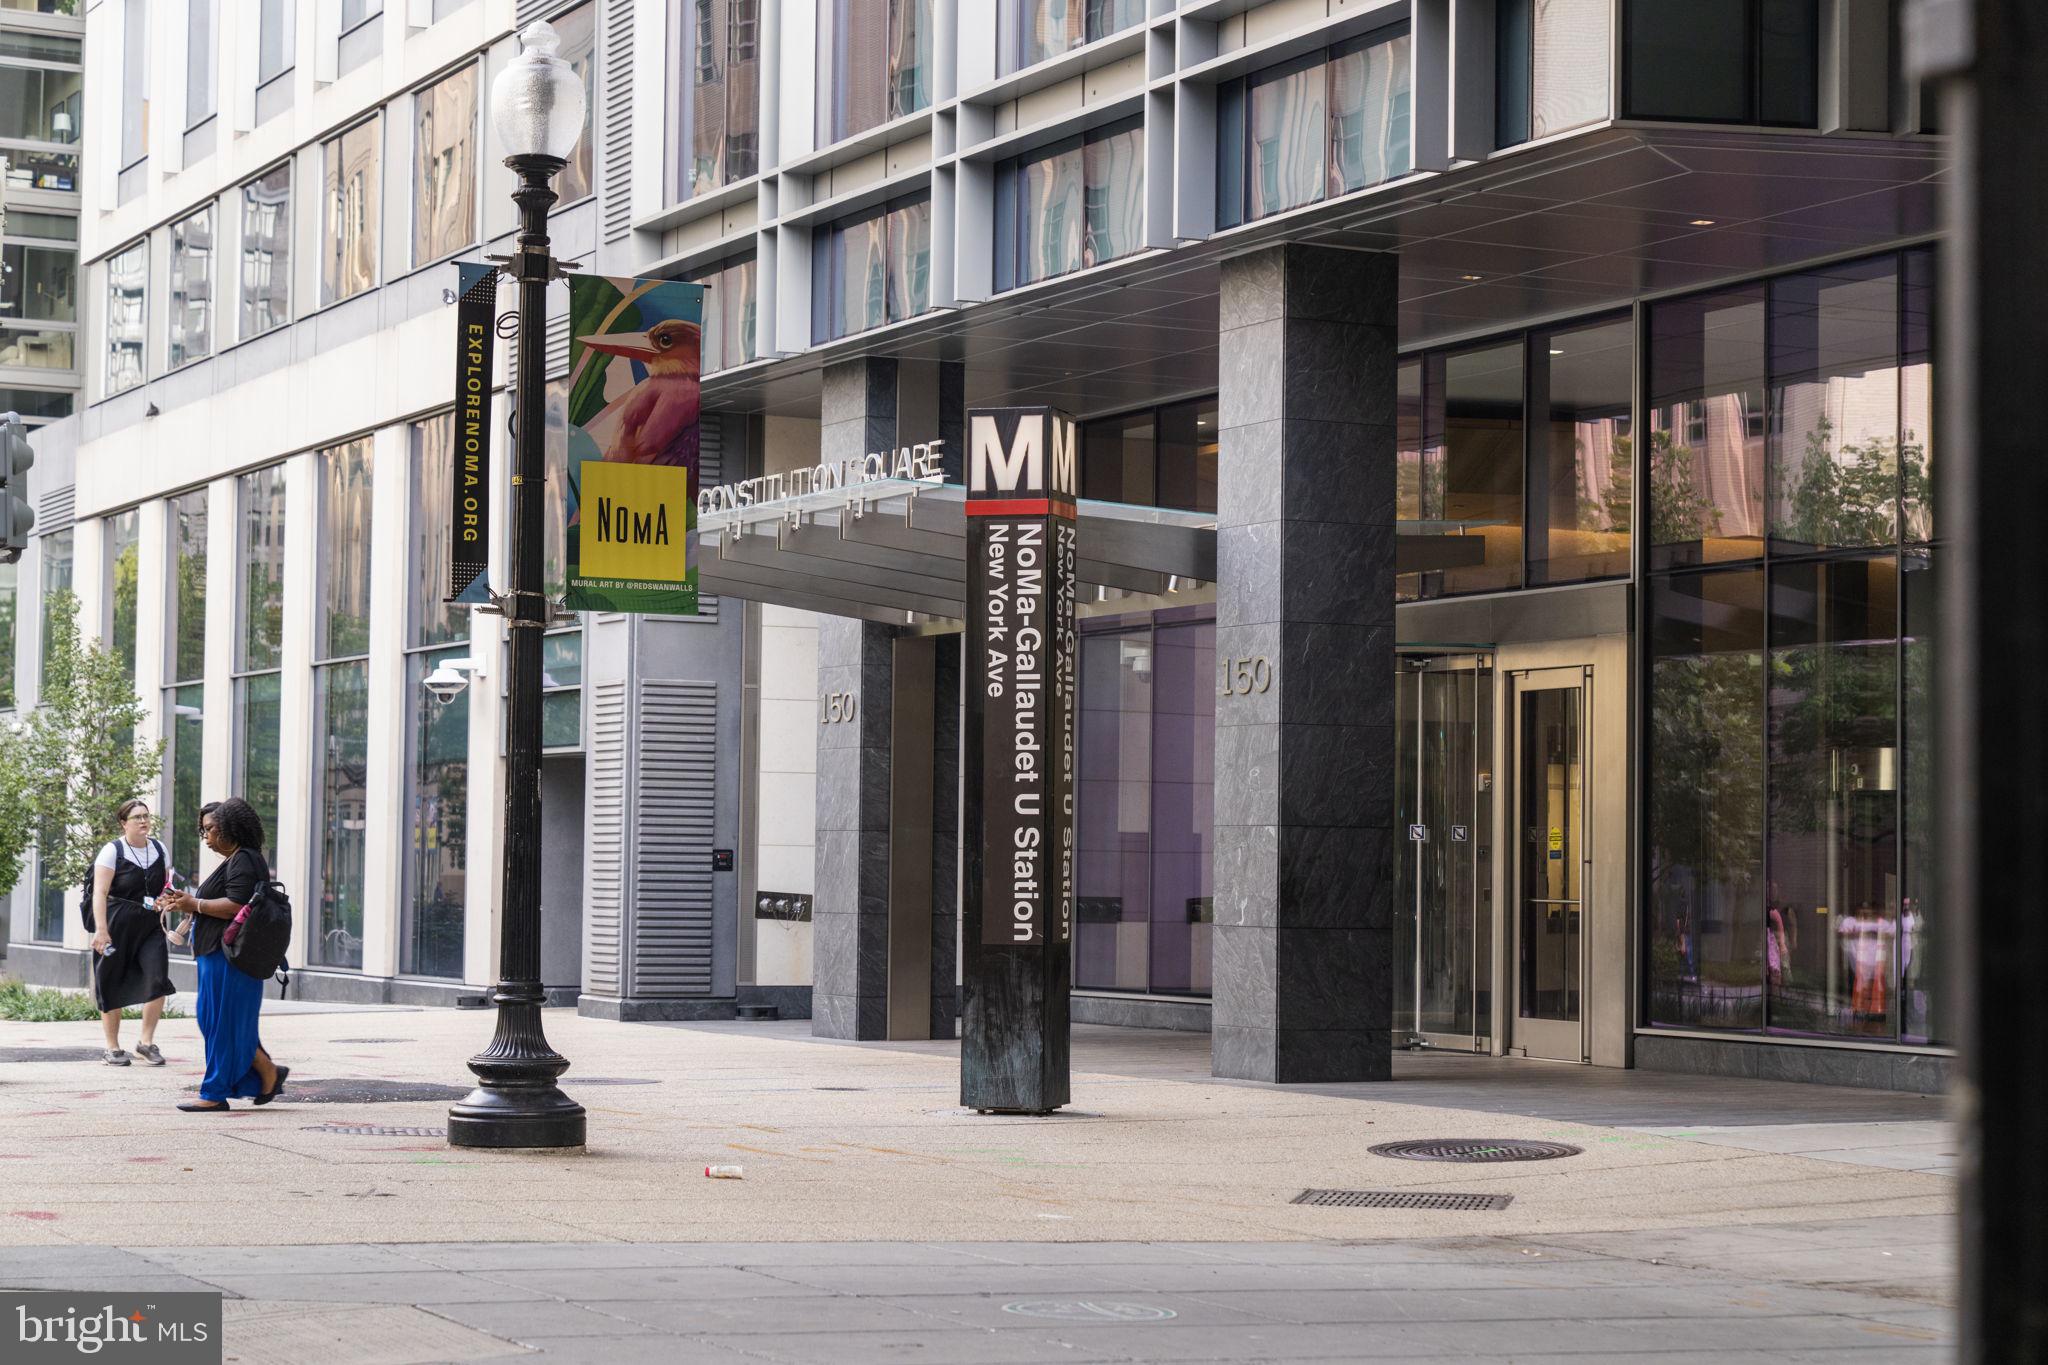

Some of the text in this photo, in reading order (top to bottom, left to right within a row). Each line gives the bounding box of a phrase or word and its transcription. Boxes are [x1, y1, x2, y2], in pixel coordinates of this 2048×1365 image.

[463, 324, 483, 541] EXPLORENOMA.ORG
[971, 415, 1043, 491] M
[1052, 416, 1075, 496] M
[698, 440, 945, 517] CONSTITUTION SQUARE
[571, 579, 693, 592] MURAL ART BY @REDSWANWALLS
[987, 524, 1009, 698] New York Ave
[1056, 525, 1066, 698] New York Ave
[820, 693, 855, 724] 150
[1222, 656, 1271, 695] 150
[1013, 524, 1042, 941] NoMa-Gallaudet U Station
[1062, 527, 1076, 940] NoMa-Gallaudet U Station
